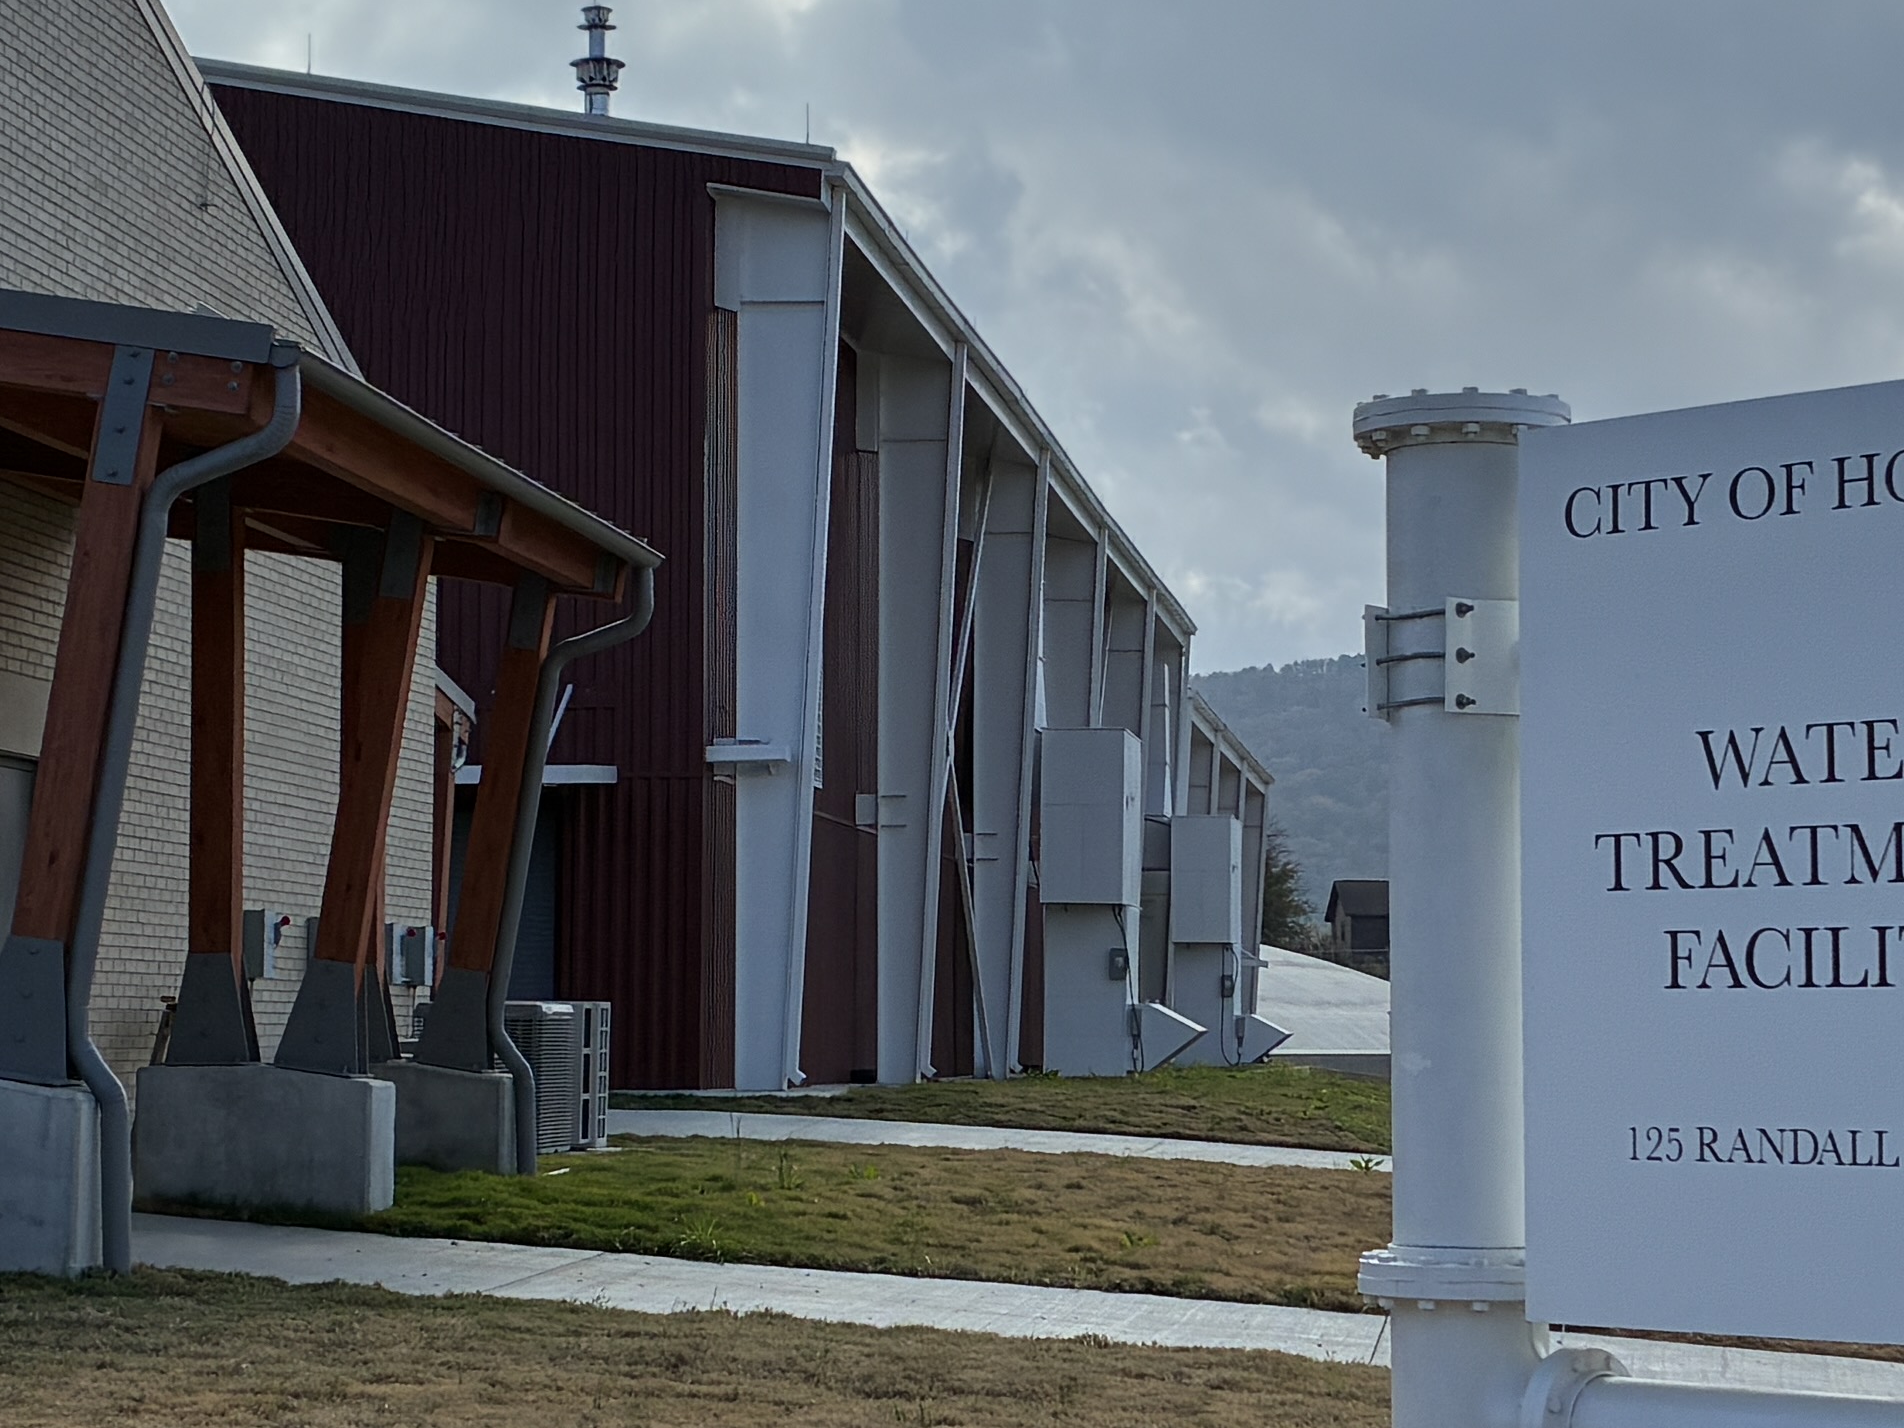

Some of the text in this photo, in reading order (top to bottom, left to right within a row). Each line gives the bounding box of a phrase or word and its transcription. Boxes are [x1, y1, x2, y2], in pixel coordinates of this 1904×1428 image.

[1565, 473, 1712, 538] CITY
[1730, 461, 1813, 520] OF
[1629, 1126, 1683, 1162] 125
[1695, 1126, 1899, 1167] RANDALL
